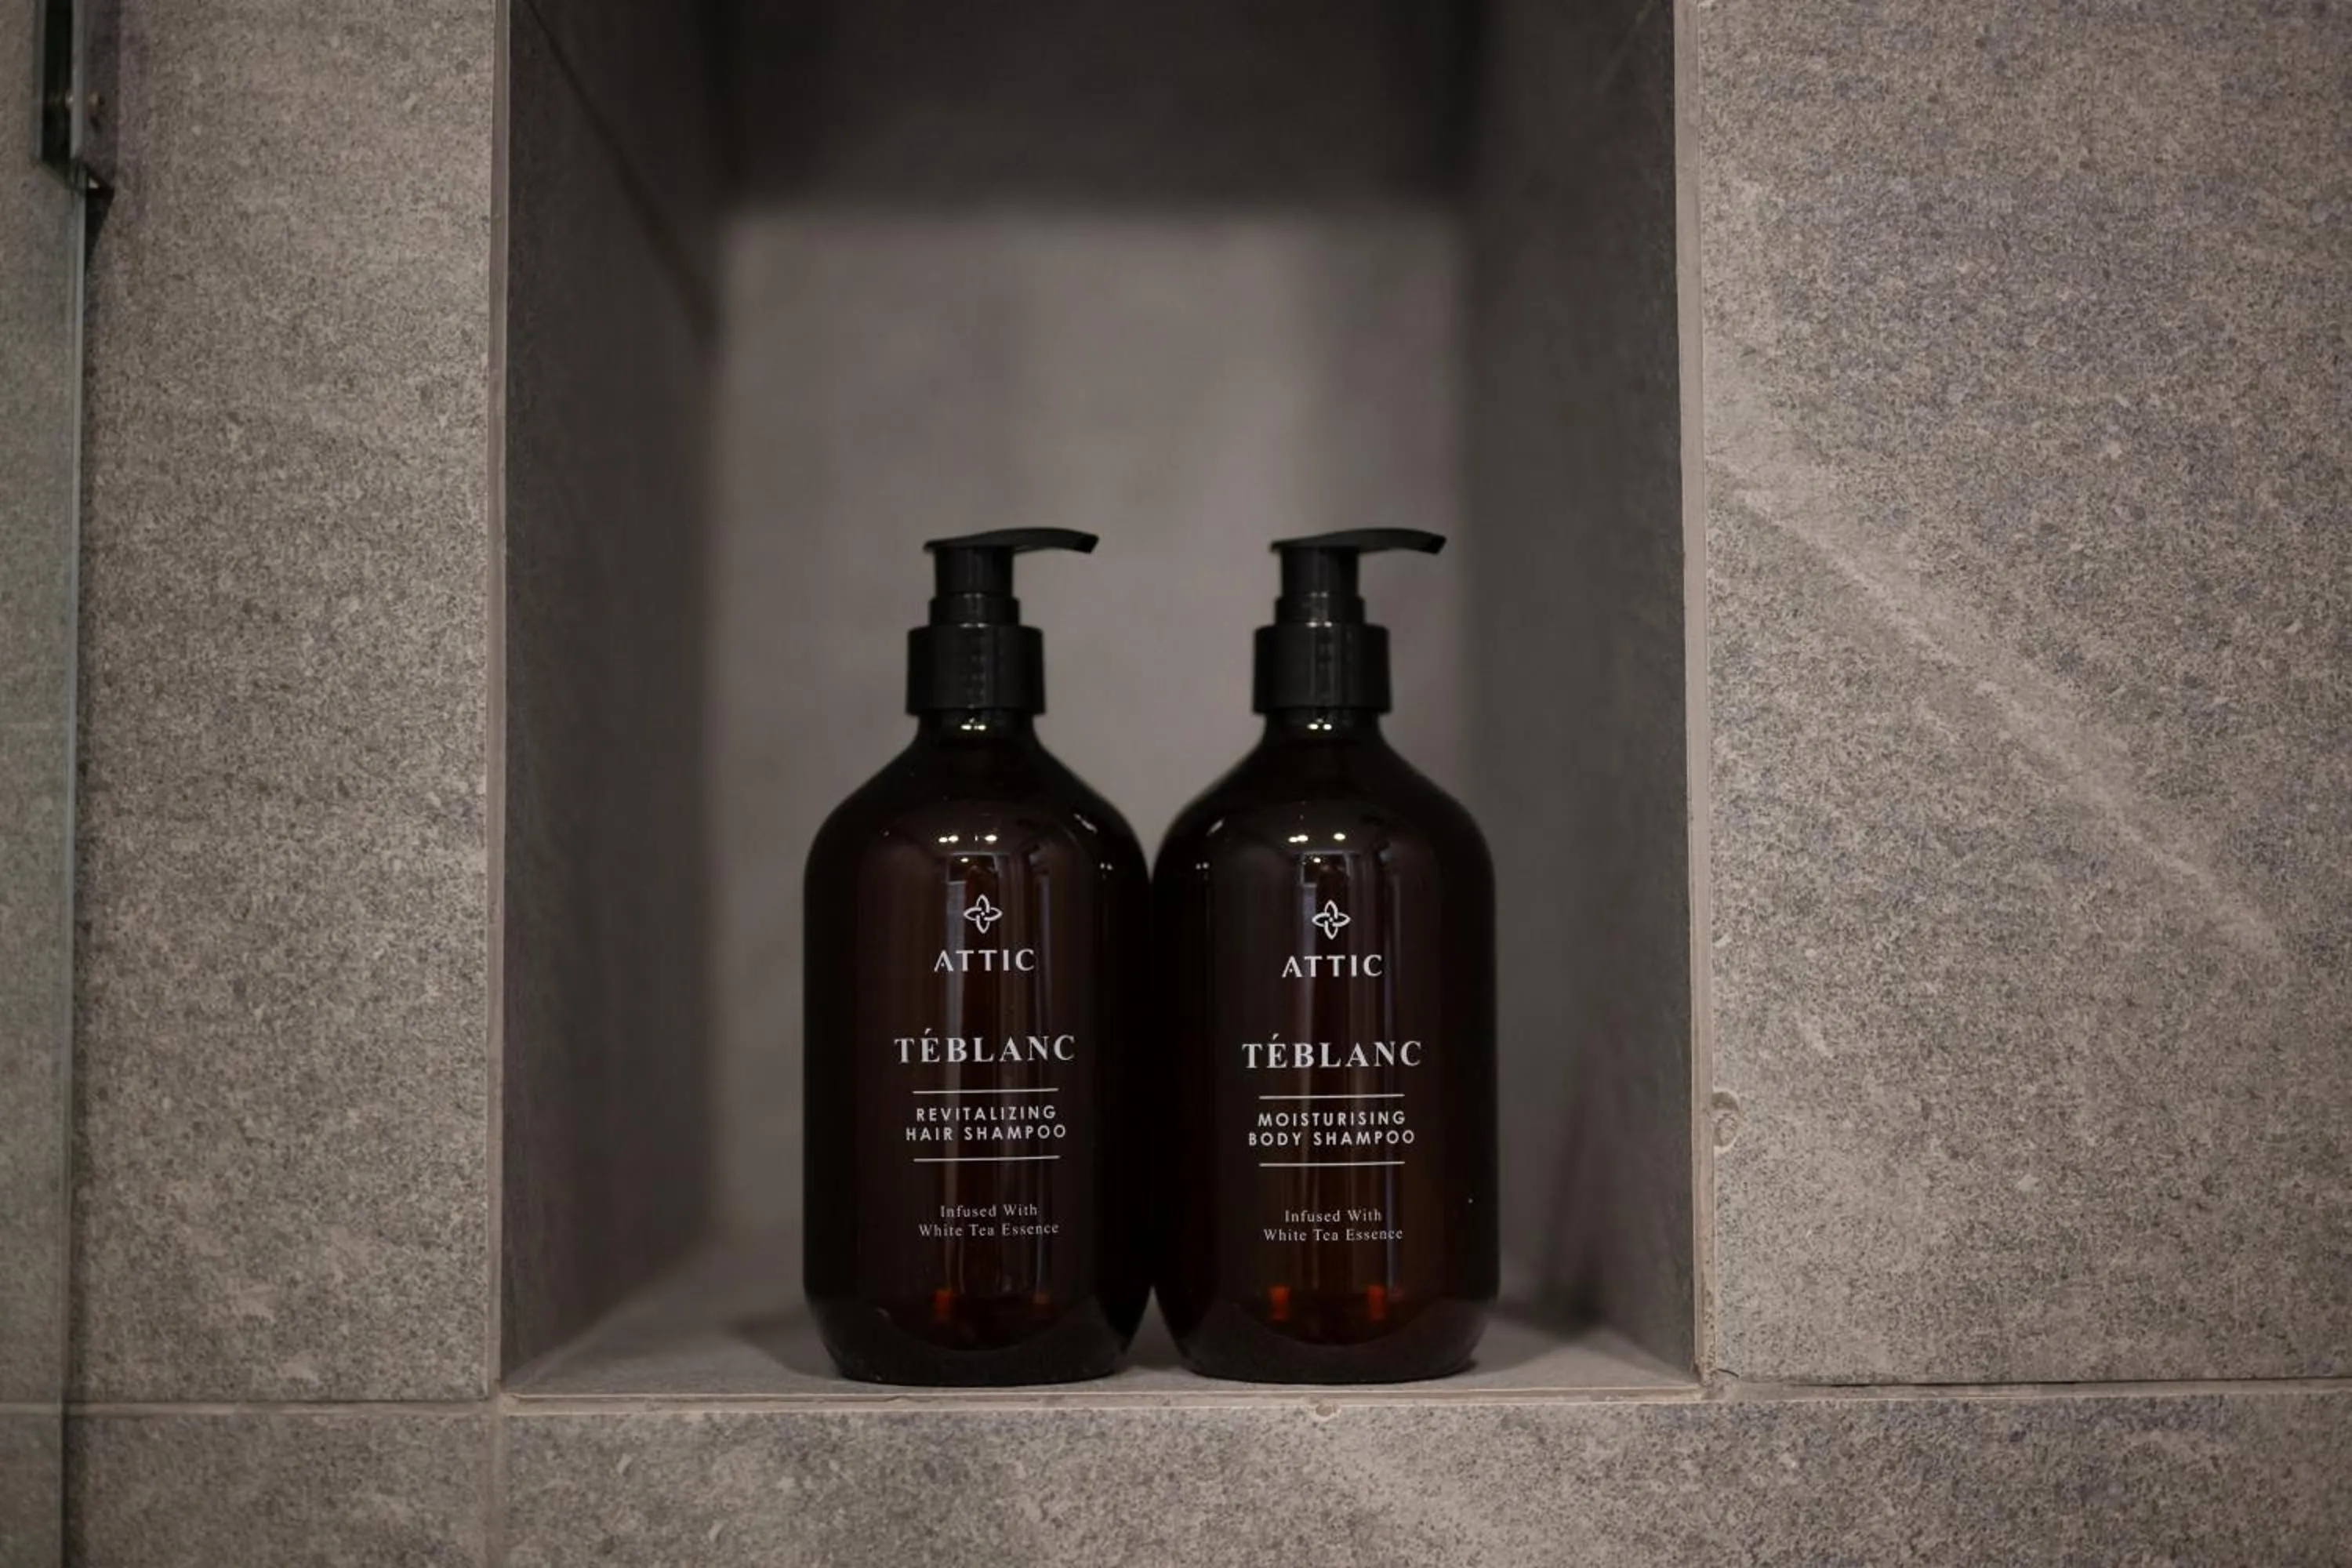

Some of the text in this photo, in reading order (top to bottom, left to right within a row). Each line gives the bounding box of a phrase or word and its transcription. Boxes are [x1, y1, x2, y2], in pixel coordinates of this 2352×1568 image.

[934, 949, 1035, 972] ATTIC
[1282, 954, 1383, 978] ATTIC
[894, 1029, 1076, 1063] TÉBLANC
[1242, 1033, 1421, 1069] TÉBLANC
[916, 1105, 1057, 1121] REVITALIZING
[1258, 1111, 1406, 1127] MOISTURISING
[906, 1125, 1066, 1141] HAIR SHAMPOO
[1248, 1130, 1415, 1146] BODY SHAMPOO
[940, 1203, 1038, 1218] Infused With
[1284, 1209, 1382, 1222] Infused With
[918, 1222, 1059, 1236] White Tea Essence
[1263, 1228, 1403, 1241] White Tea Essence
